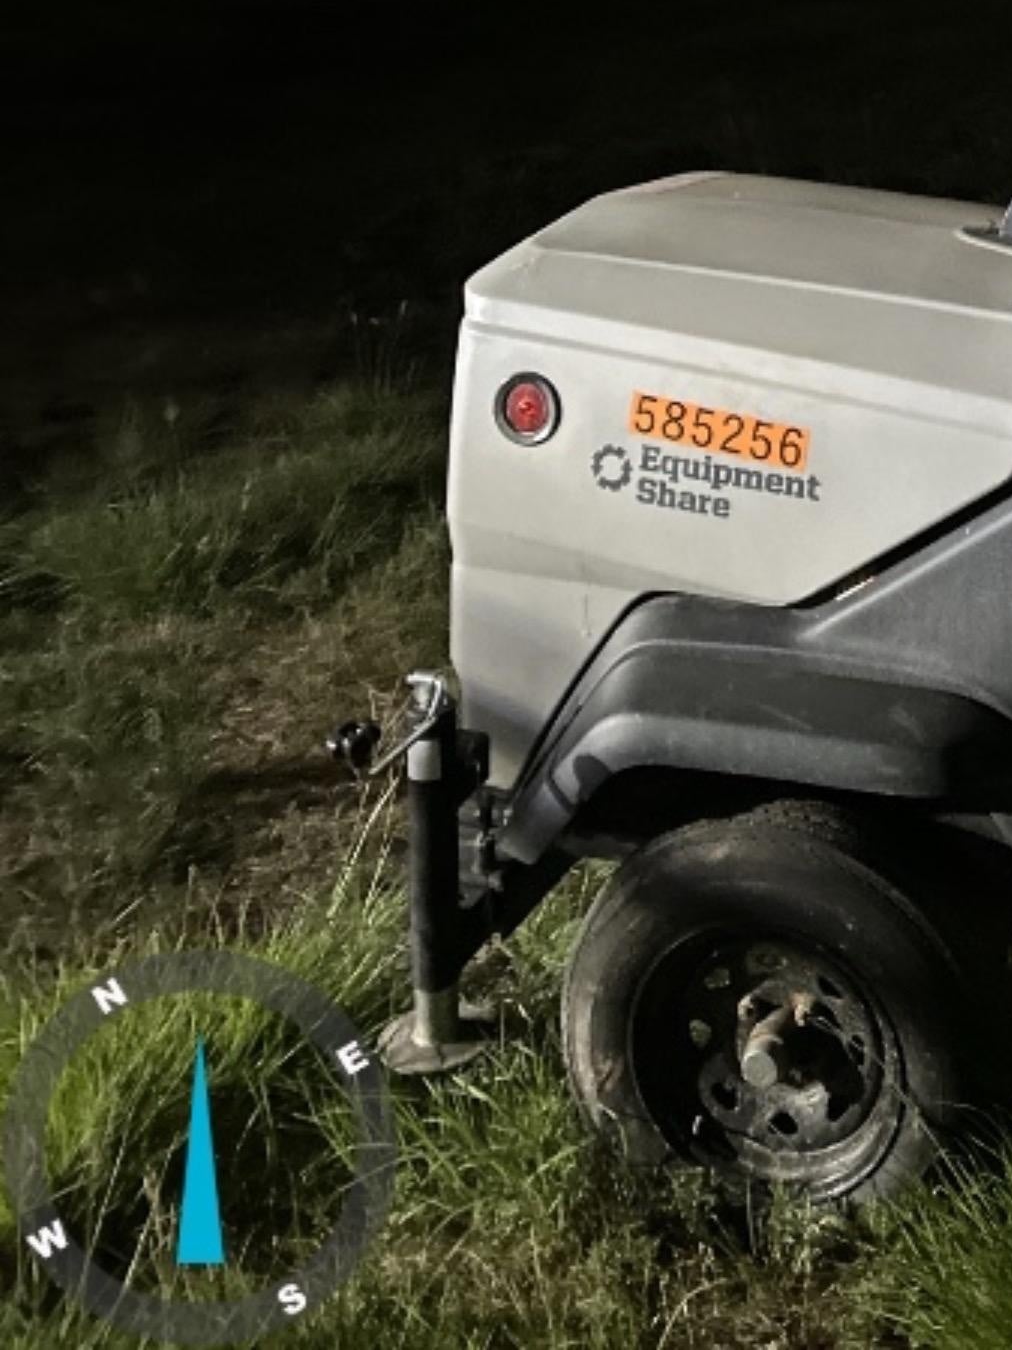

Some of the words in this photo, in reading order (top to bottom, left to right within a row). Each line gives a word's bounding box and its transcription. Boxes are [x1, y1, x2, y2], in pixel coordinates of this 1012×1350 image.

[634, 394, 804, 467] 585256
[632, 475, 731, 518] Share
[638, 443, 821, 502] Equipment
